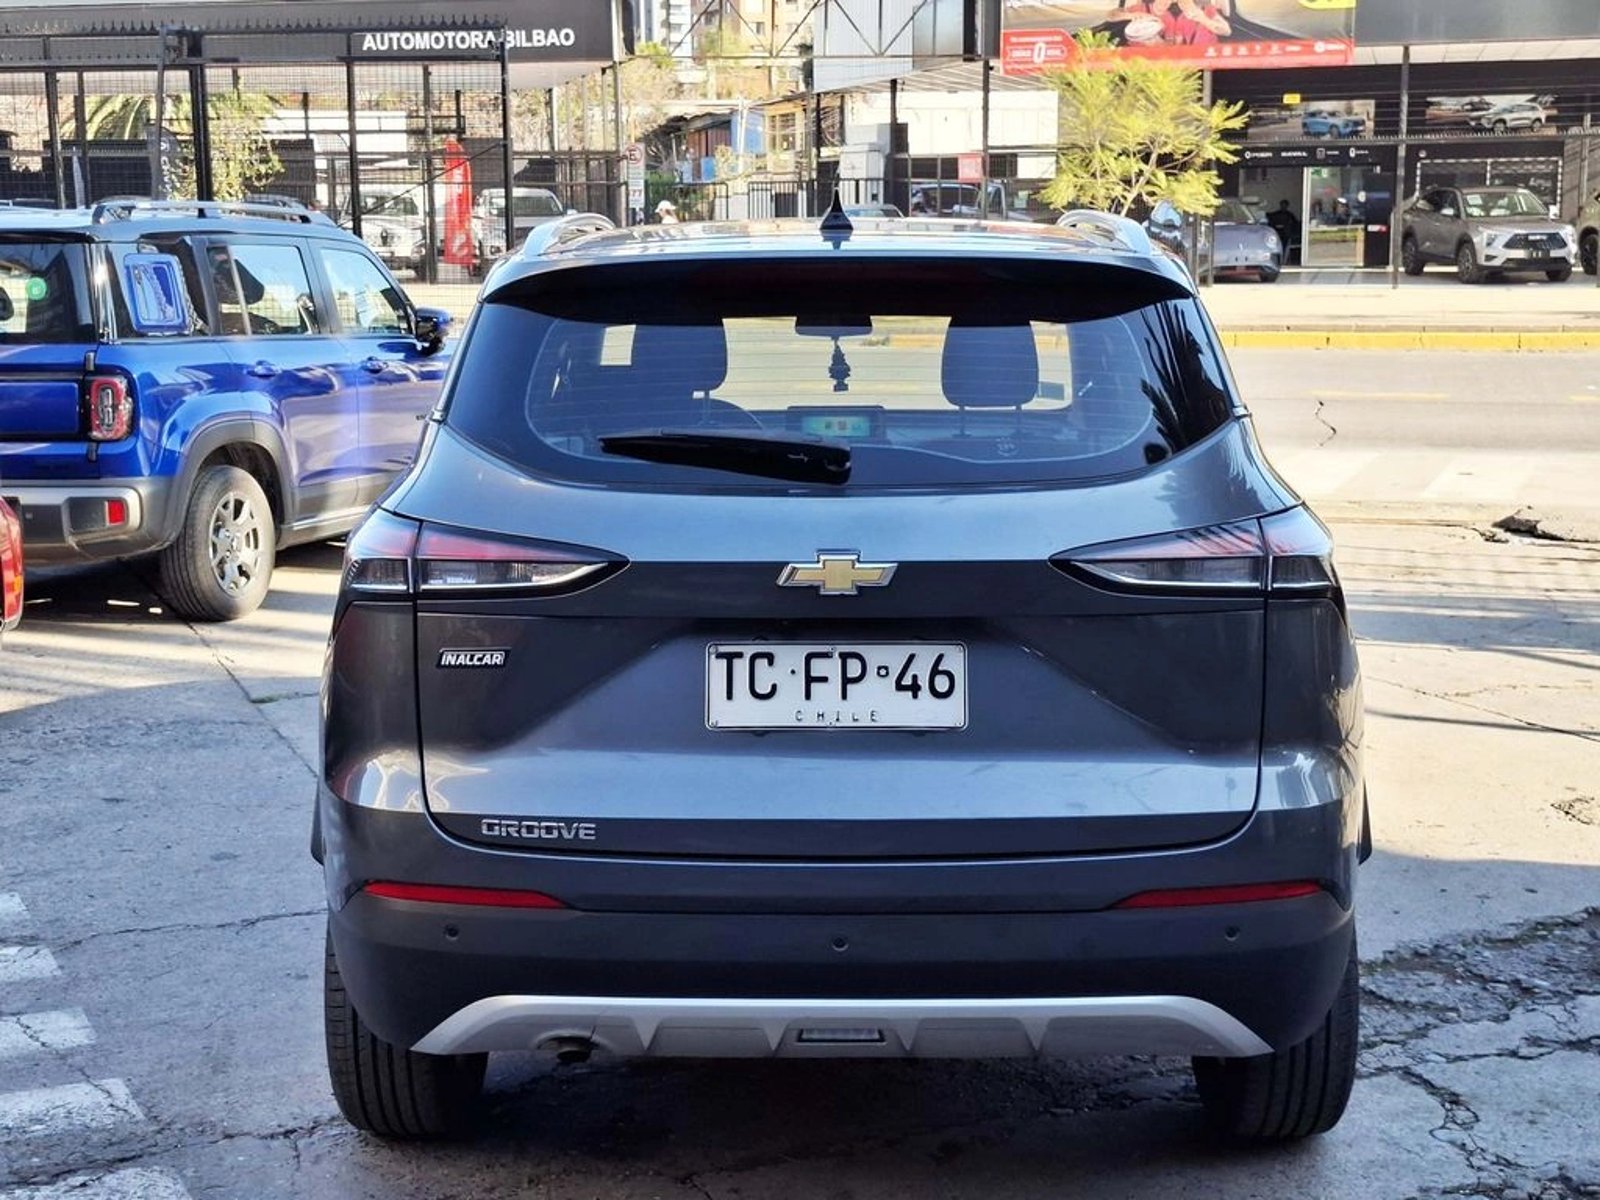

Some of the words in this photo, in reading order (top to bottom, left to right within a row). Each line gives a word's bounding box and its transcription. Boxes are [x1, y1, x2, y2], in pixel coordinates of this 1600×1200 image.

[362, 31, 497, 51] AUTOMOTORA
[505, 28, 576, 48] BILBAO
[441, 653, 503, 665] INALCAR
[795, 710, 878, 722] CHILE
[481, 819, 596, 840] GROOVE
